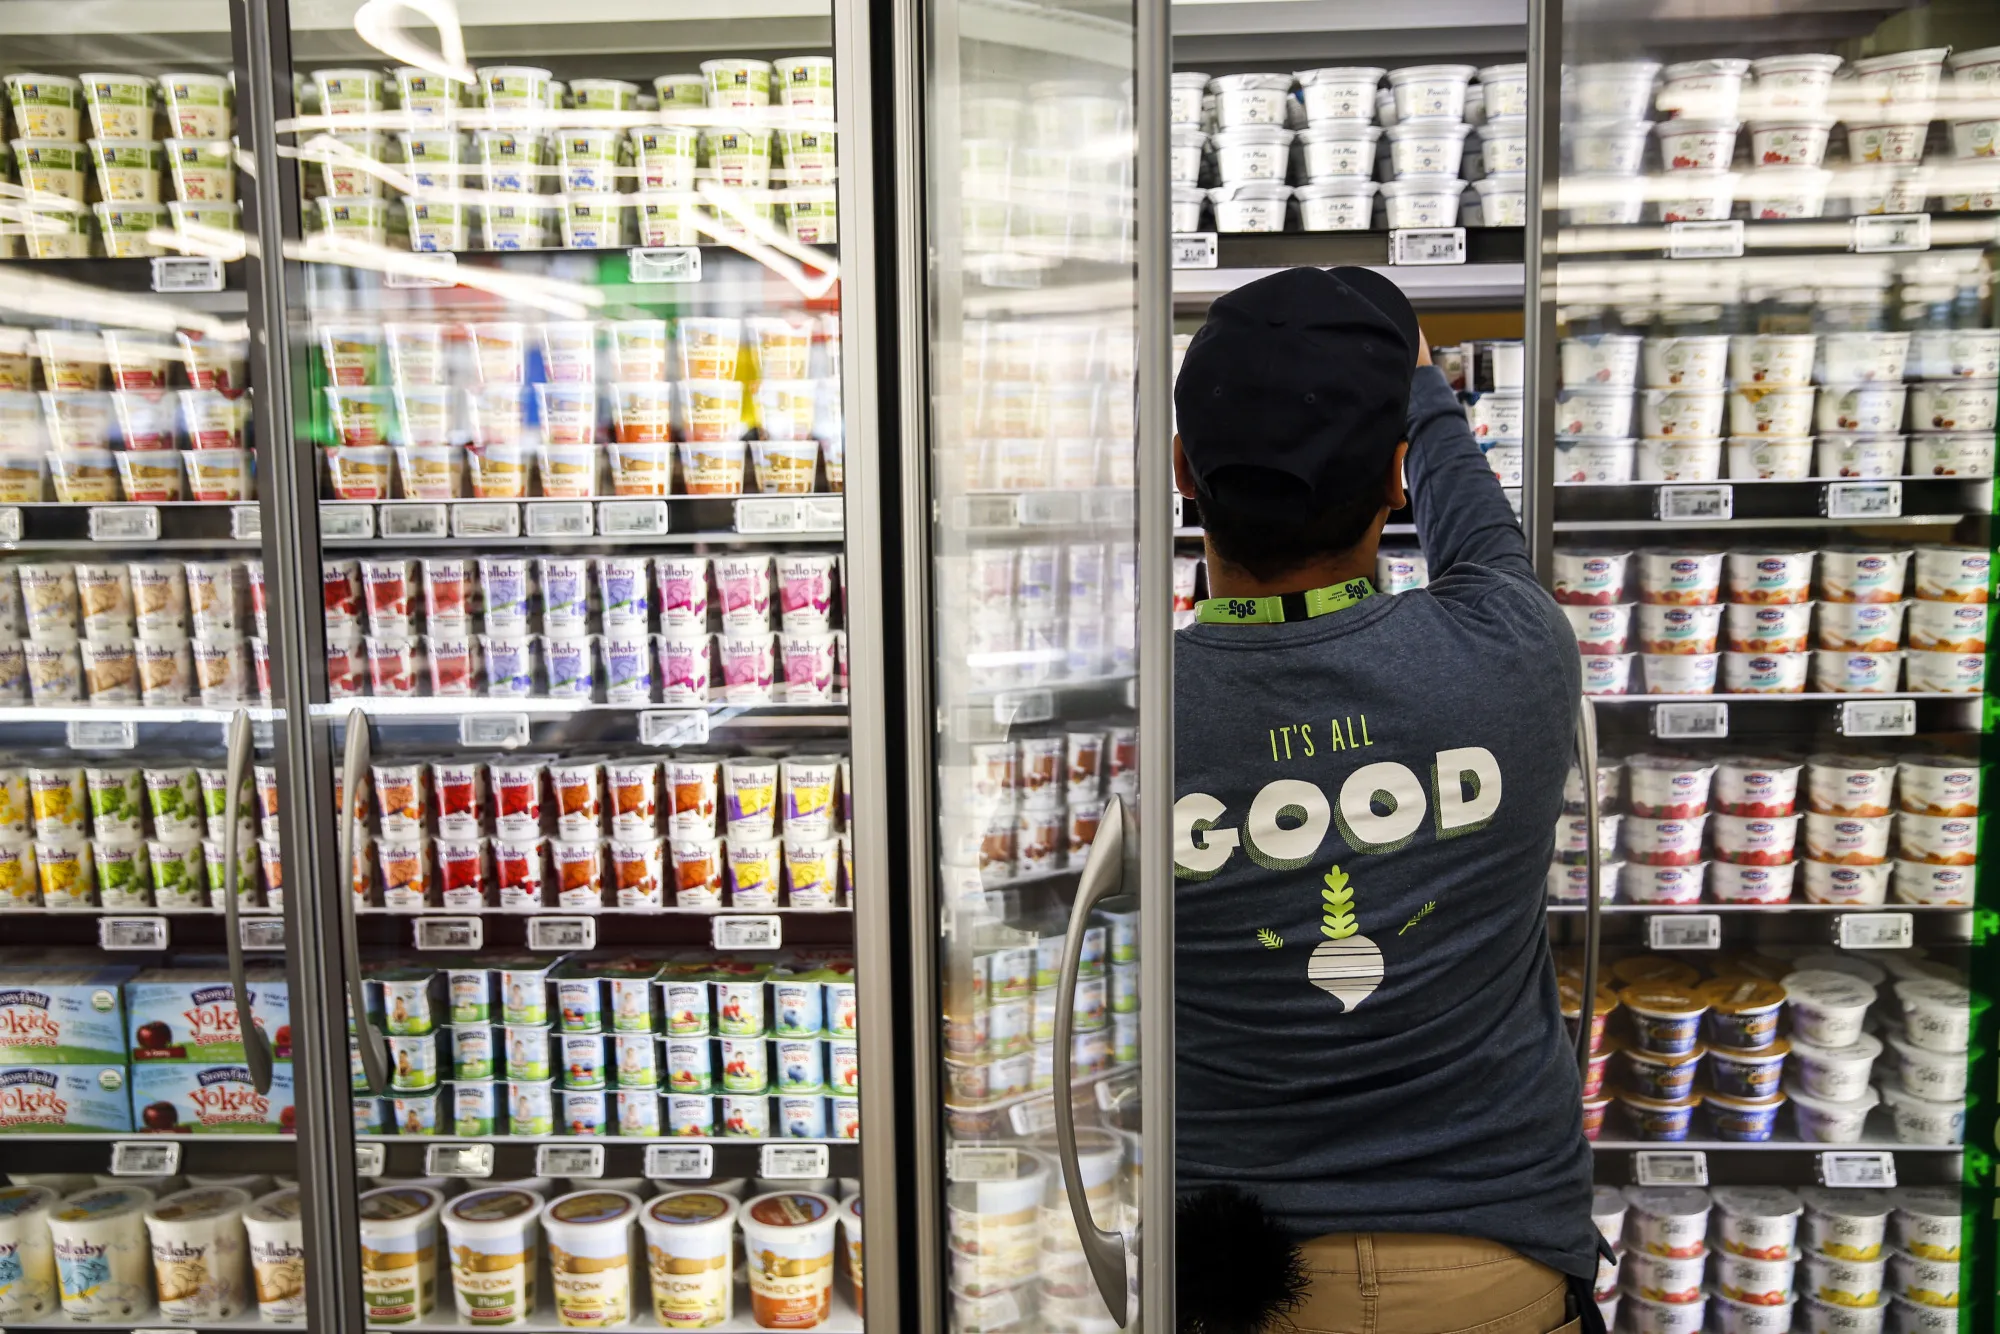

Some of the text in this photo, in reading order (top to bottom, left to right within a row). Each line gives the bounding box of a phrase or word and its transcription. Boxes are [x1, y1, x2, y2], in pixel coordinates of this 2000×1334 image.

[1343, 579, 1369, 600] 365
[1228, 599, 1257, 619] 365
[1269, 714, 1374, 762] IT'S ALL
[1174, 746, 1502, 877] GOOD
[477, 1295, 506, 1306] Plain
